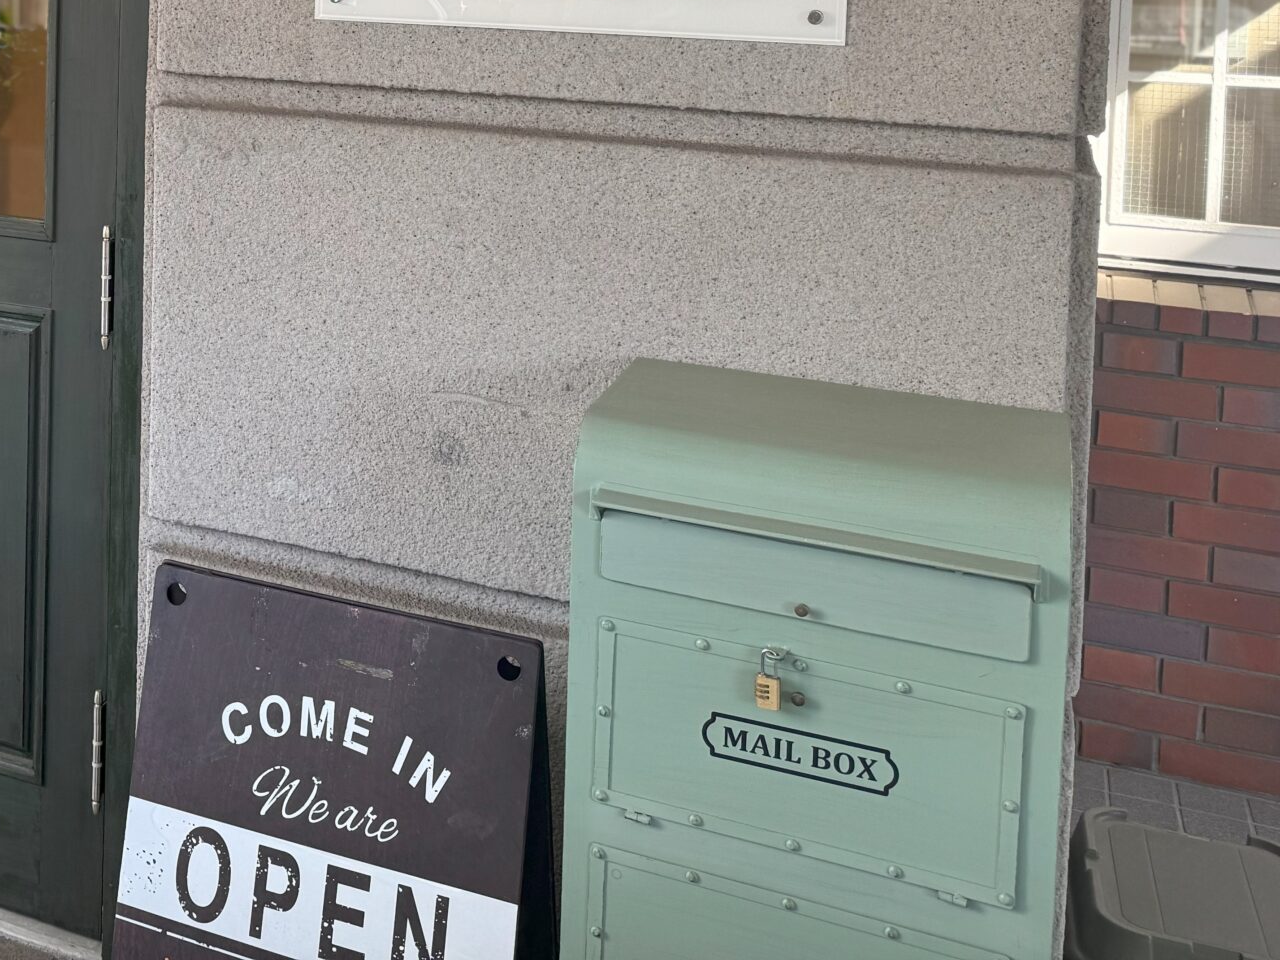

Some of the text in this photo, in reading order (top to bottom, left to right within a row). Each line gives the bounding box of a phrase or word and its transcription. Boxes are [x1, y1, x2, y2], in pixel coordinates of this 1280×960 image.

[221, 694, 452, 804] COME IN
[723, 726, 878, 782] MAIL BOX
[252, 766, 399, 842] We are
[175, 826, 451, 960] OPEN
